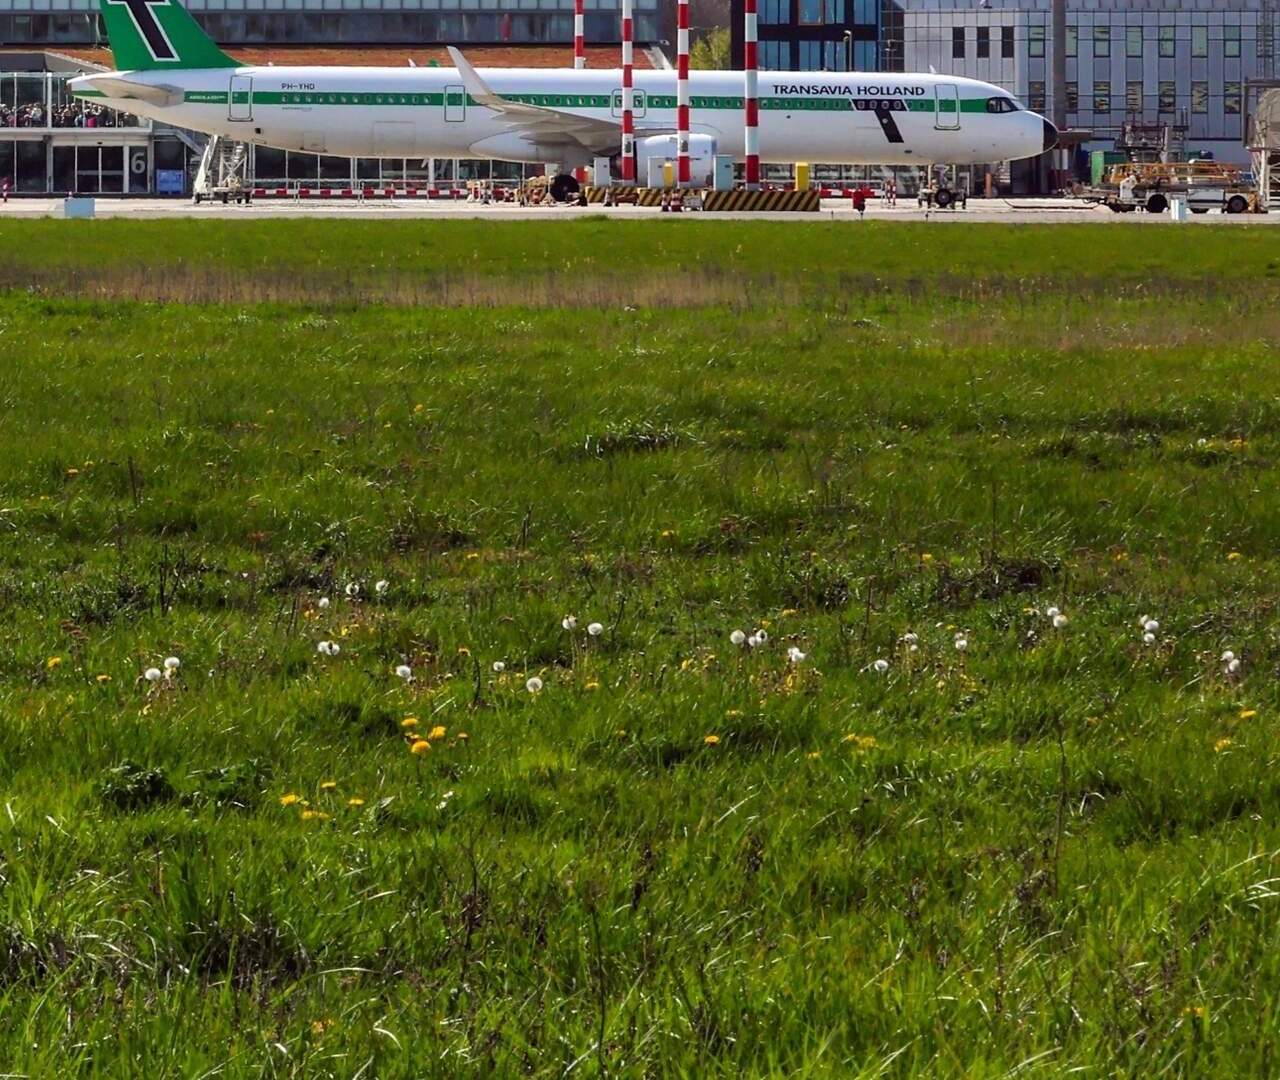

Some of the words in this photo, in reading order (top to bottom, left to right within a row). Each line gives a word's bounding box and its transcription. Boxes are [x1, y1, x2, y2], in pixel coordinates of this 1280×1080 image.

[773, 84, 852, 96] TRANSAVIA
[857, 86, 925, 96] HOLLAND
[131, 152, 146, 174] 6
